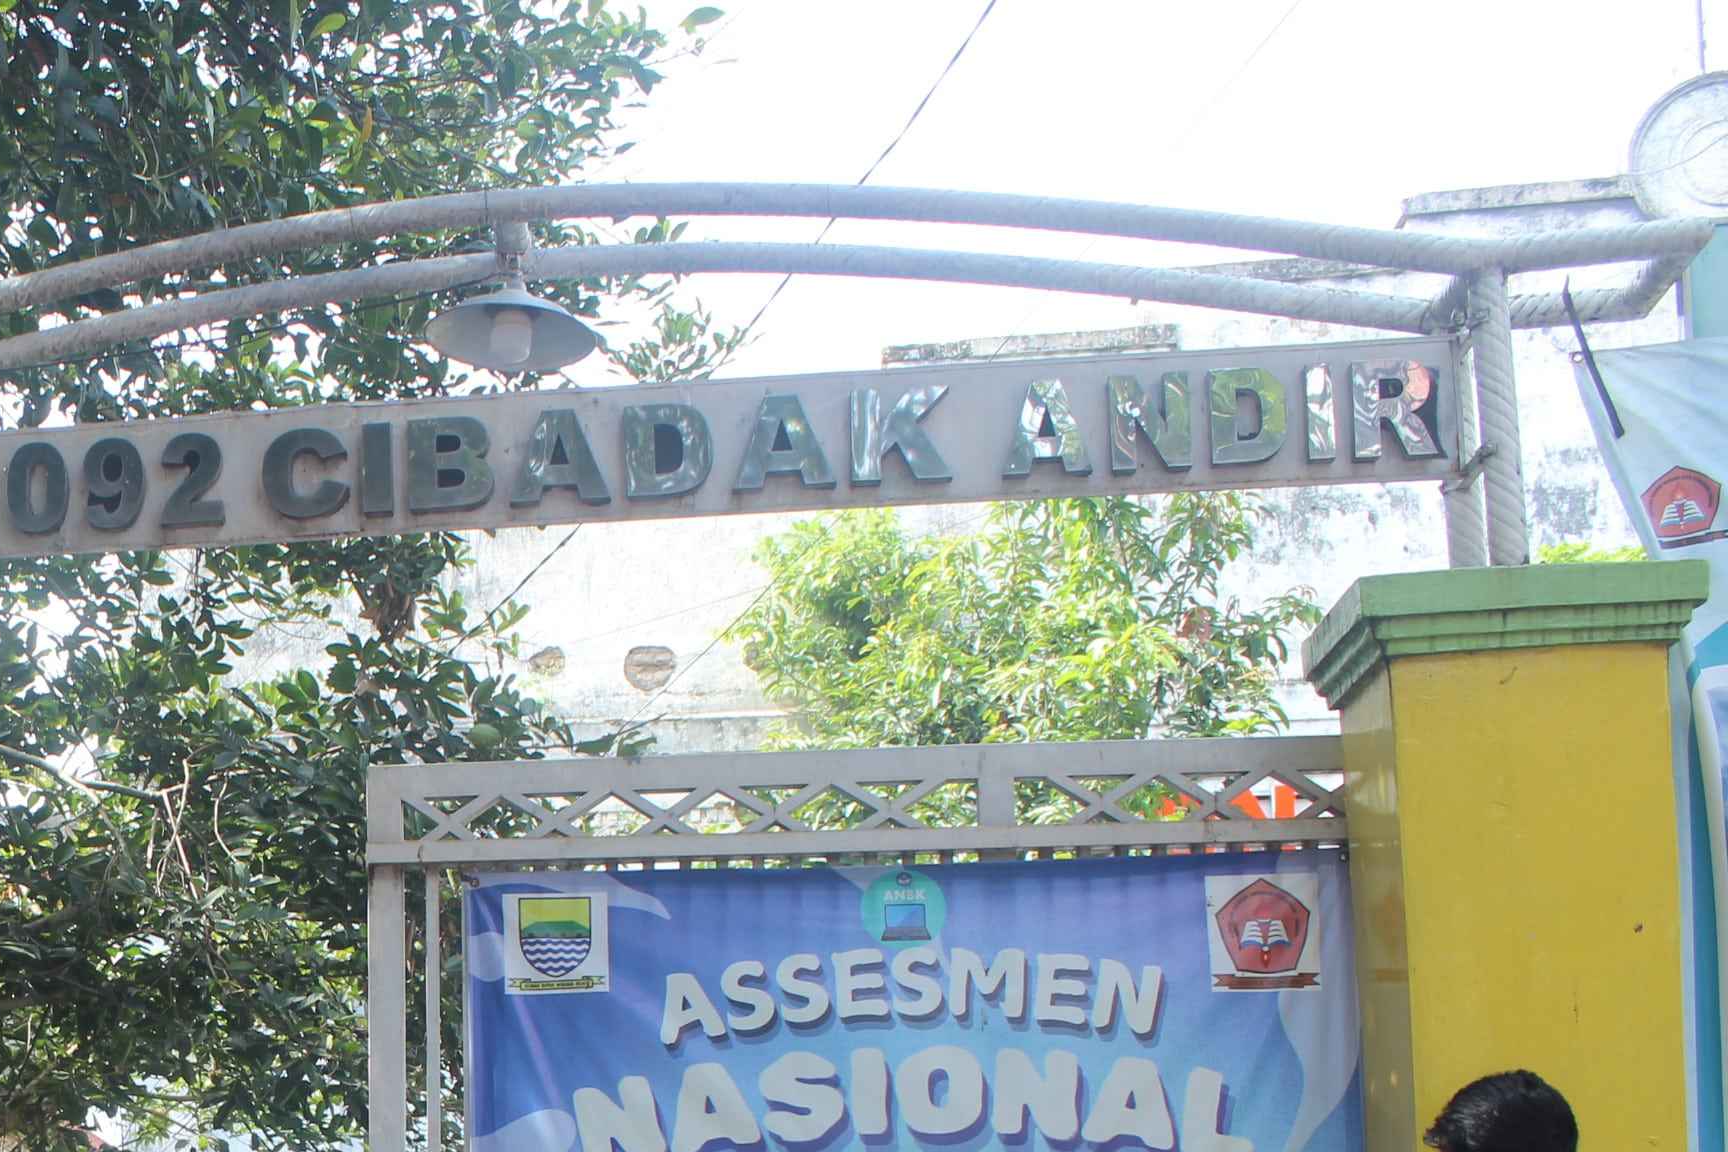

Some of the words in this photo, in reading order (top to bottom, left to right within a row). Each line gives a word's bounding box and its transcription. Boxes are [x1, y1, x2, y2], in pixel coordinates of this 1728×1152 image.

[3, 432, 228, 535] 092
[261, 383, 954, 521] CIBADAK
[1000, 357, 1449, 480] ANDIR
[884, 889, 928, 901] ANBK
[660, 946, 1163, 1046] ASSESMEN
